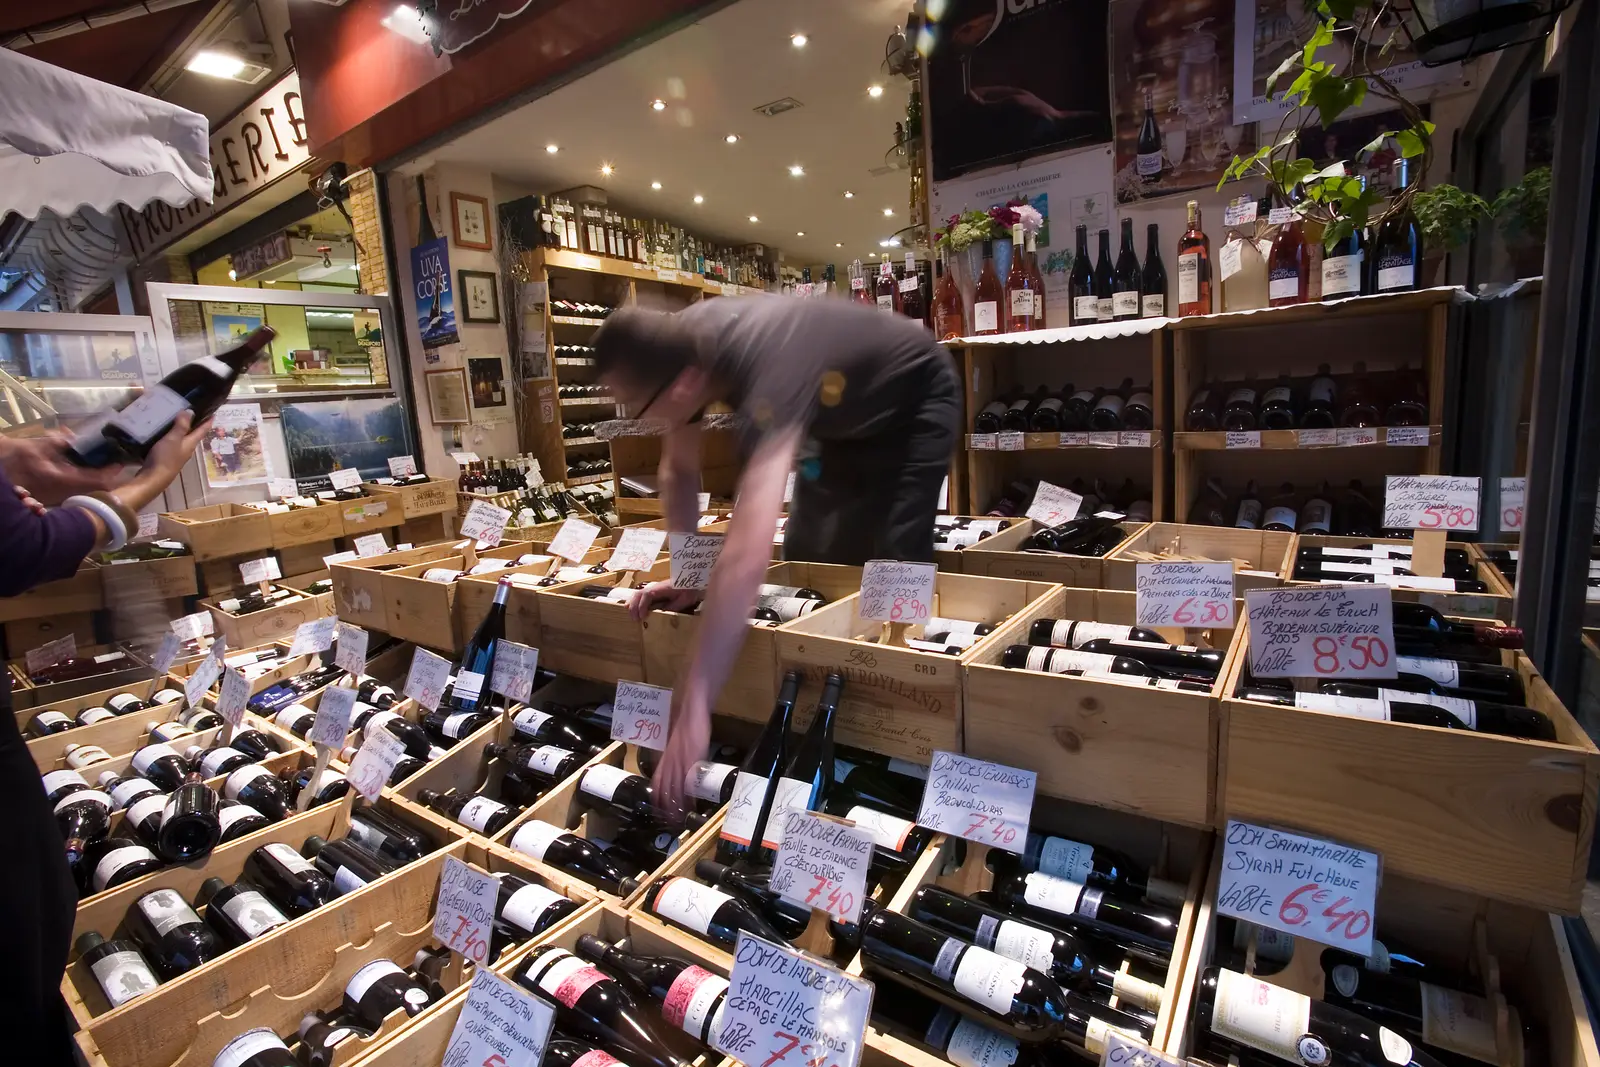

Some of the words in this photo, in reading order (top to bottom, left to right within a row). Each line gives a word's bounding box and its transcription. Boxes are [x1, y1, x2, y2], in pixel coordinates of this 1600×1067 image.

[420, 255, 442, 277] UVA
[1151, 563, 1204, 575] BORDEAUX
[891, 587, 920, 599] 2005
[1269, 591, 1347, 604] BORDEAUX
[1314, 602, 1332, 617] LE
[1268, 633, 1301, 646] 2005
[914, 663, 937, 676] CRD
[857, 669, 942, 714] ROYLLAND
[821, 850, 858, 870] GARANCE
[1227, 850, 1283, 875] SYRAH
